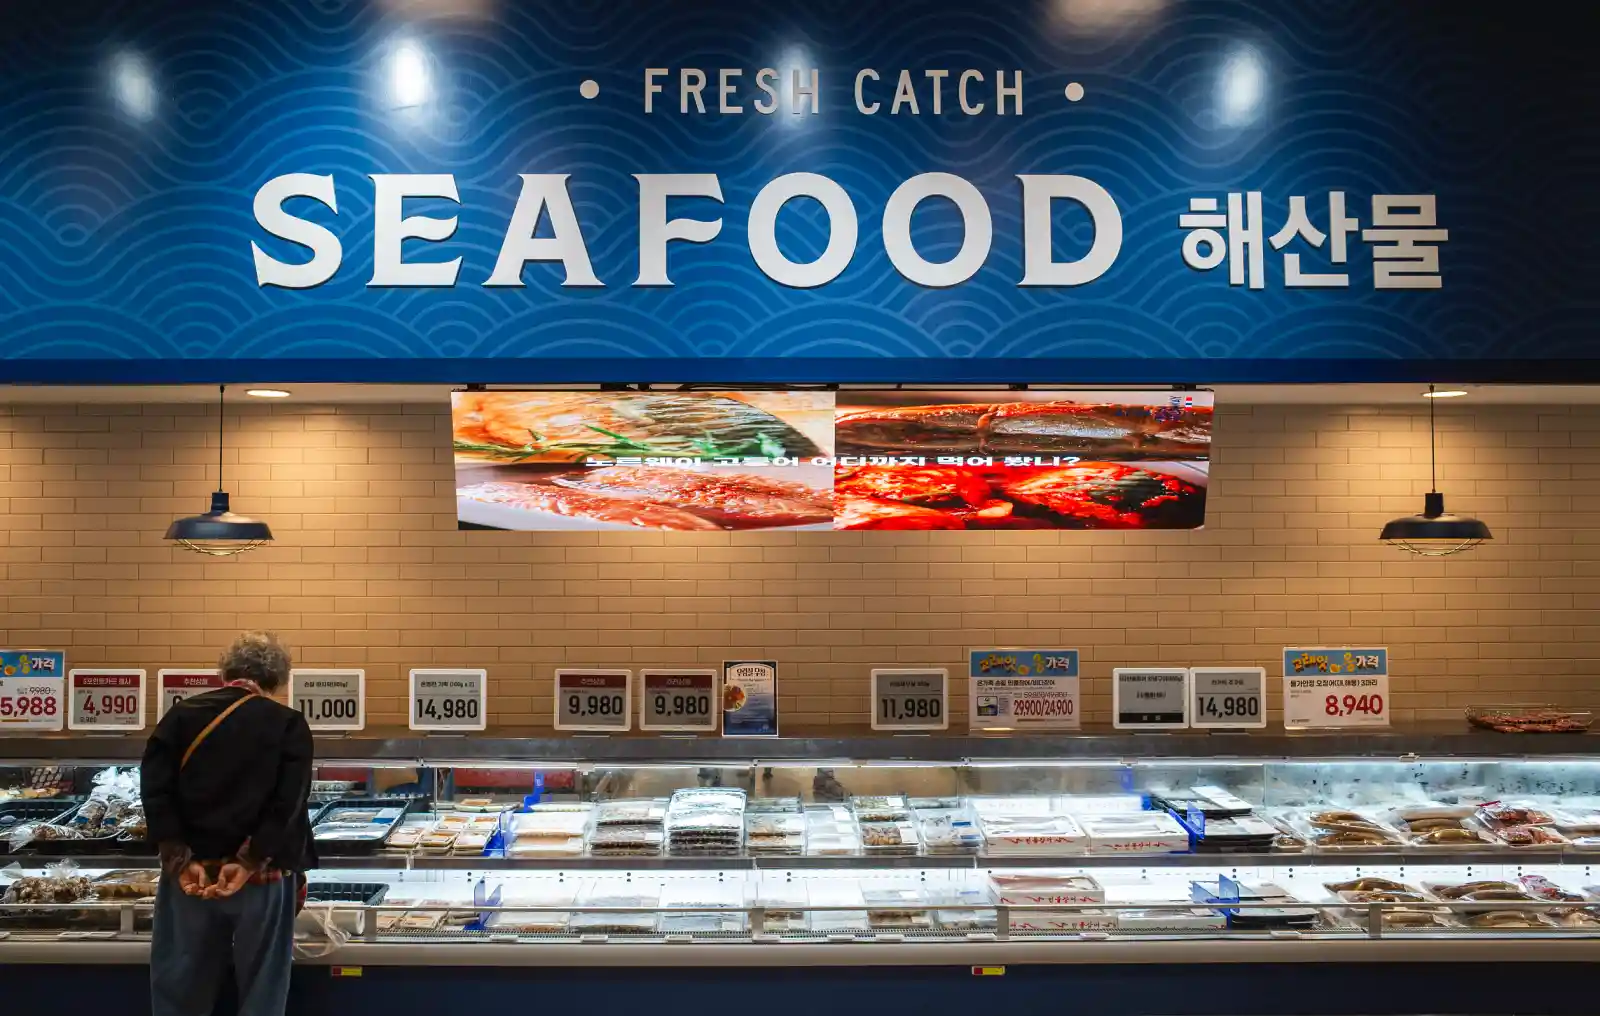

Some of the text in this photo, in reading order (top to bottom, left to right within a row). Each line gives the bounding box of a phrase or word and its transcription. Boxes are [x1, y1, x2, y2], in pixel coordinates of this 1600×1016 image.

[644, 67, 1024, 116] FRESH CATCH
[251, 172, 1123, 288] SEAFOOD
[1178, 190, 1449, 291] 해산물
[586, 456, 701, 467] 노르웨이
[713, 456, 798, 467] 고등어
[810, 456, 925, 467] 어디까지
[936, 456, 993, 467] 먹어
[31, 657, 55, 672] 가격
[1045, 656, 1070, 671] 가격
[1356, 655, 1379, 669] 가격
[0, 696, 57, 717] 5,988
[83, 695, 137, 716] 4,990
[299, 698, 356, 720] 11,000
[417, 698, 478, 720] 14,980
[568, 695, 623, 717] 9,980
[655, 695, 709, 717] 9,980
[882, 698, 940, 720] 11,980
[1013, 698, 1073, 717] 29,900/24,900
[1198, 696, 1258, 719] 14,980
[1325, 694, 1384, 717] 8,940
